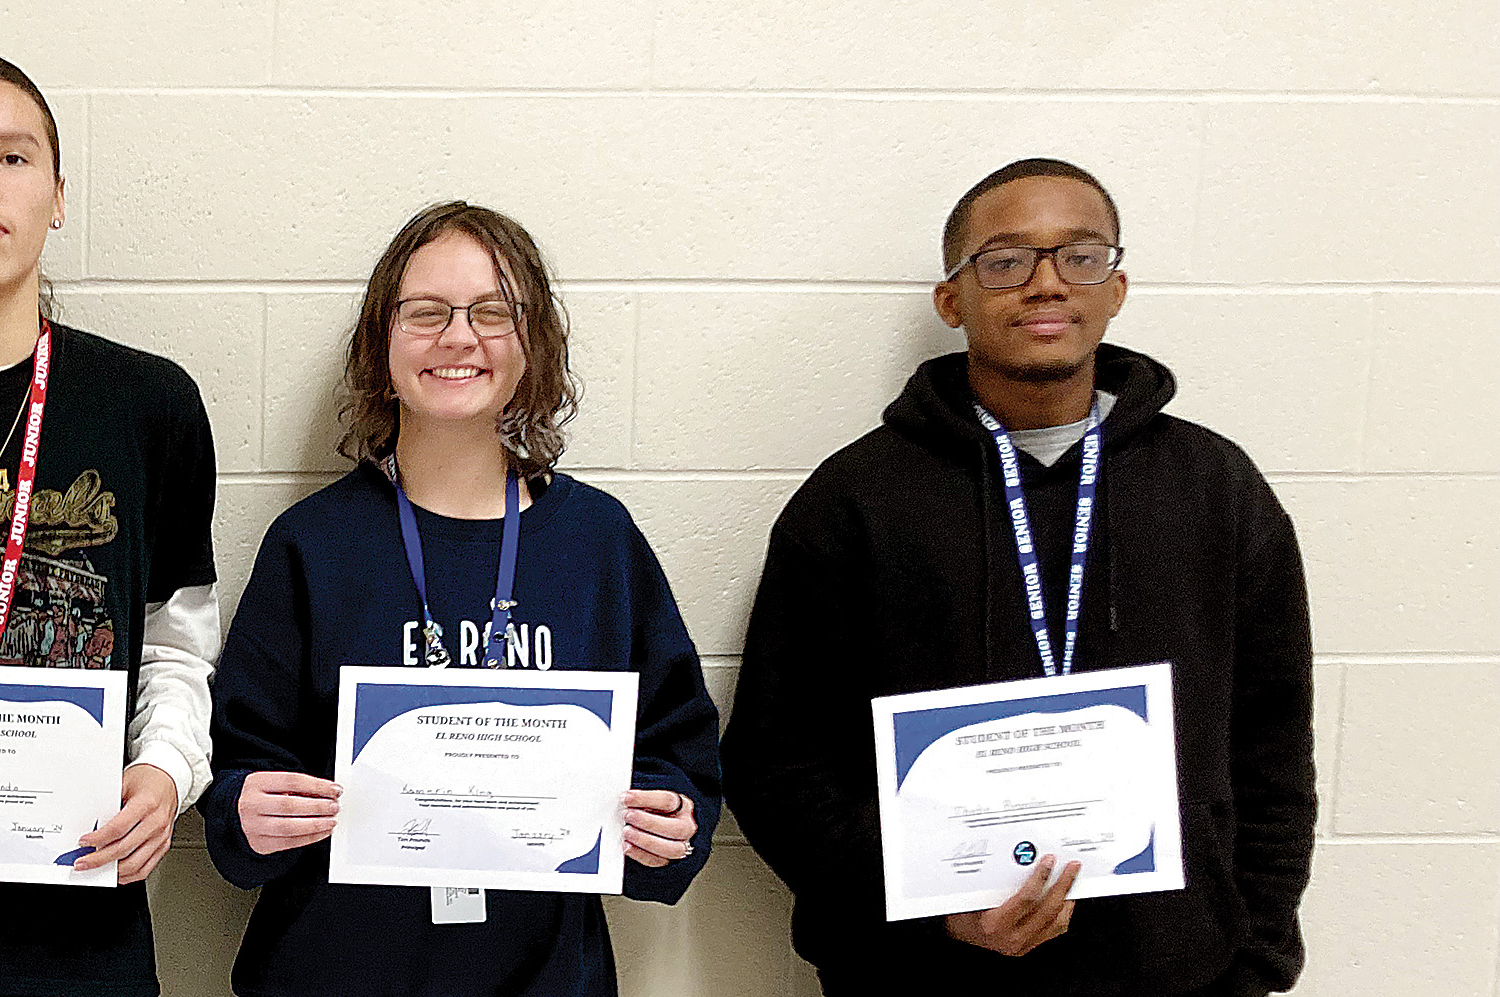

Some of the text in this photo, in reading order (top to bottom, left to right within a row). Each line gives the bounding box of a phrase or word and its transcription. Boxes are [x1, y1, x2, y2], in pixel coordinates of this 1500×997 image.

[22, 402, 44, 467] JUNIOR
[996, 434, 1020, 487] SENIOR
[10, 480, 32, 545] JUNIOR
[1010, 497, 1033, 554] SENIOR
[1073, 497, 1092, 553] SENIOR
[1023, 563, 1044, 620] SENIOR
[1067, 564, 1083, 620] SENIOR
[1036, 629, 1056, 676] ENIOR
[0, 729, 37, 738] SCHOOL
[17, 714, 61, 725] MONTH
[417, 715, 567, 729] STUDENT OF THE MONTH
[435, 732, 542, 743] EL RENO HIGH SCHOOL
